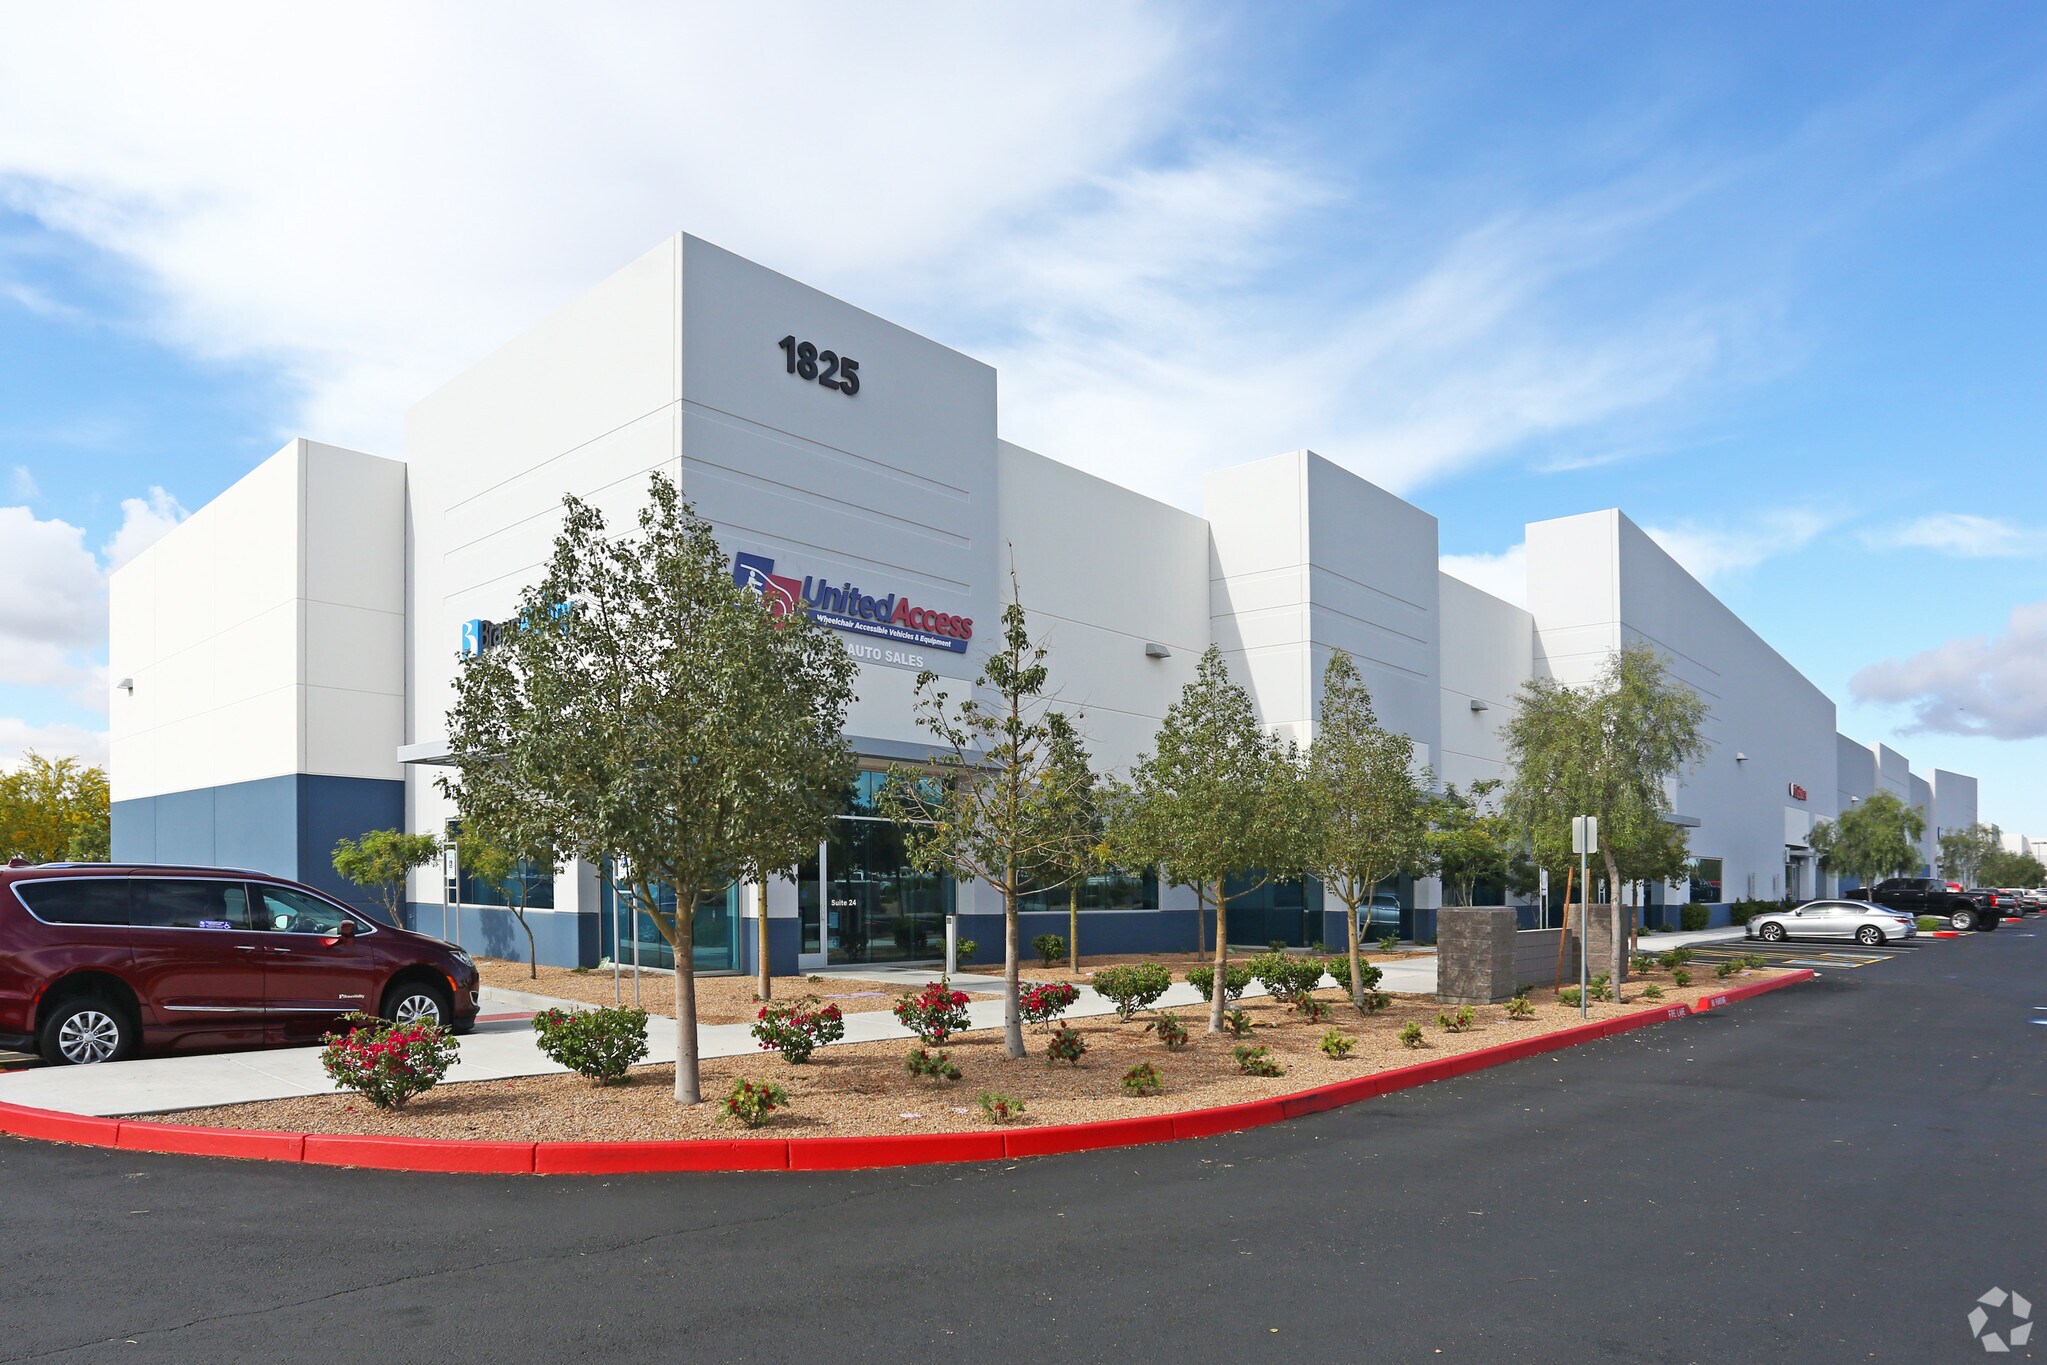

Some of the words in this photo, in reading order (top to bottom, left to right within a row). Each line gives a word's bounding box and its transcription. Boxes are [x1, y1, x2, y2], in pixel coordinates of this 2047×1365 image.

[778, 334, 860, 396] 1825
[803, 575, 973, 639] UnitedAccess
[816, 613, 854, 628] Wheelchair
[854, 621, 889, 635] Accessible
[889, 628, 914, 640] Vehicles
[920, 635, 952, 648] Equipment
[847, 643, 881, 661] AUTO
[885, 650, 924, 668] SALES
